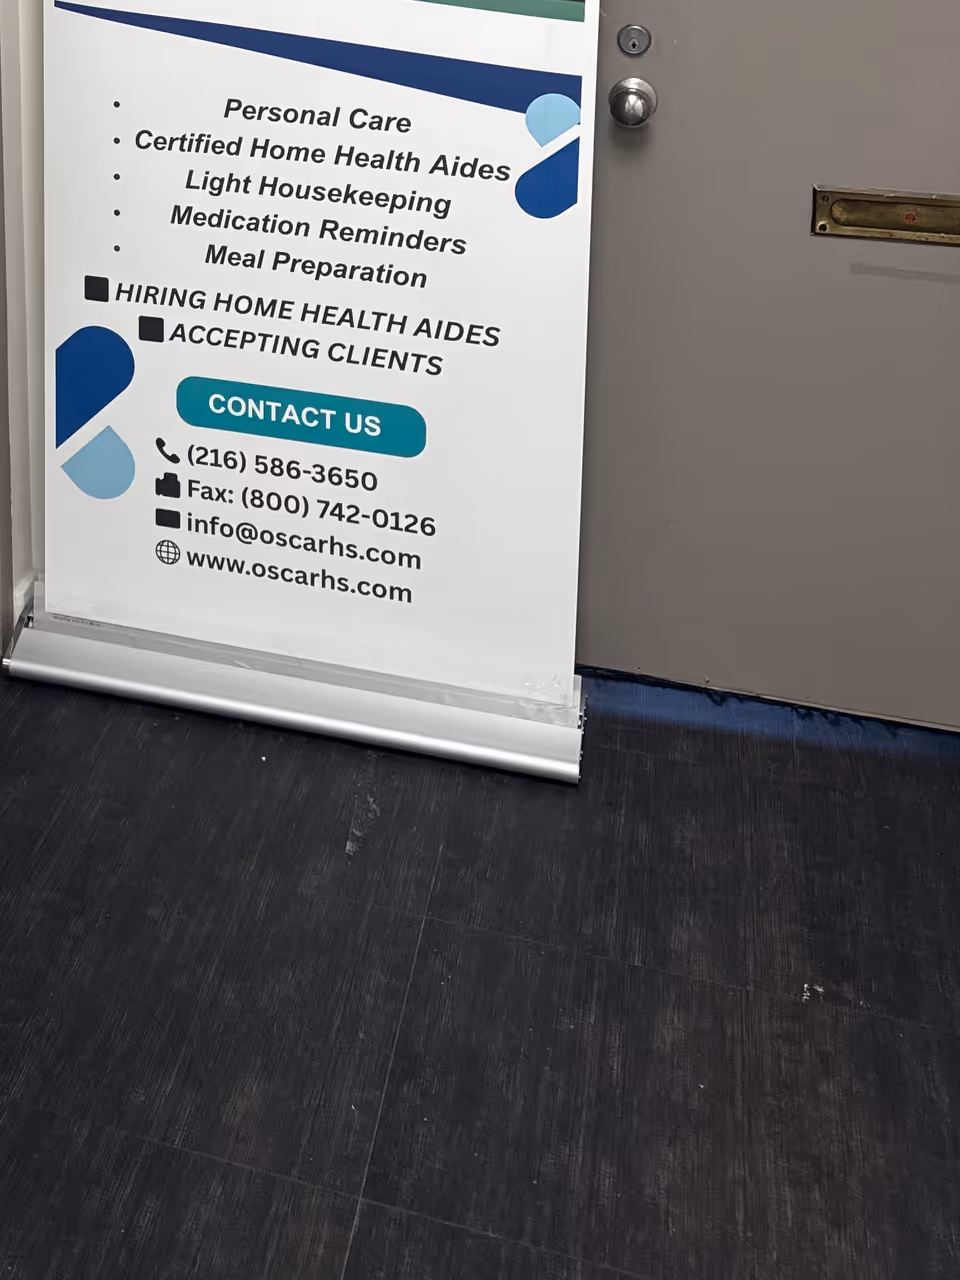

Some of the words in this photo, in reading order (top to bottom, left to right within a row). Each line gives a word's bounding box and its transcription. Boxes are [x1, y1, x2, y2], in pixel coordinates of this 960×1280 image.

[223, 98, 341, 127] Personal
[349, 107, 412, 134] Care
[135, 129, 244, 157] Certified
[249, 137, 326, 164] Home
[333, 144, 421, 173] Health
[428, 154, 512, 182] Aides
[185, 169, 252, 195] Light
[258, 175, 452, 220] Housekeeping
[170, 204, 311, 238] Medication
[318, 218, 467, 255] Reminders
[204, 243, 266, 270] Meal
[271, 250, 428, 289] Preparation
[114, 282, 207, 310] HIRING
[212, 292, 296, 321] HOME
[300, 302, 408, 335] HEALTH
[412, 317, 502, 347] AIDES
[168, 323, 321, 360] ACCEPTING
[327, 342, 444, 376] CLIENTS
[208, 393, 337, 430] CONTACT
[344, 412, 382, 437] US
[187, 443, 247, 474] (216)
[254, 454, 378, 492] 586-3650
[187, 478, 234, 505] Fax:
[241, 486, 310, 519] (800)
[316, 498, 436, 537] 742-0126
[187, 511, 421, 570] info@oscarhs.com
[186, 550, 412, 604] www.oscarhs.com
